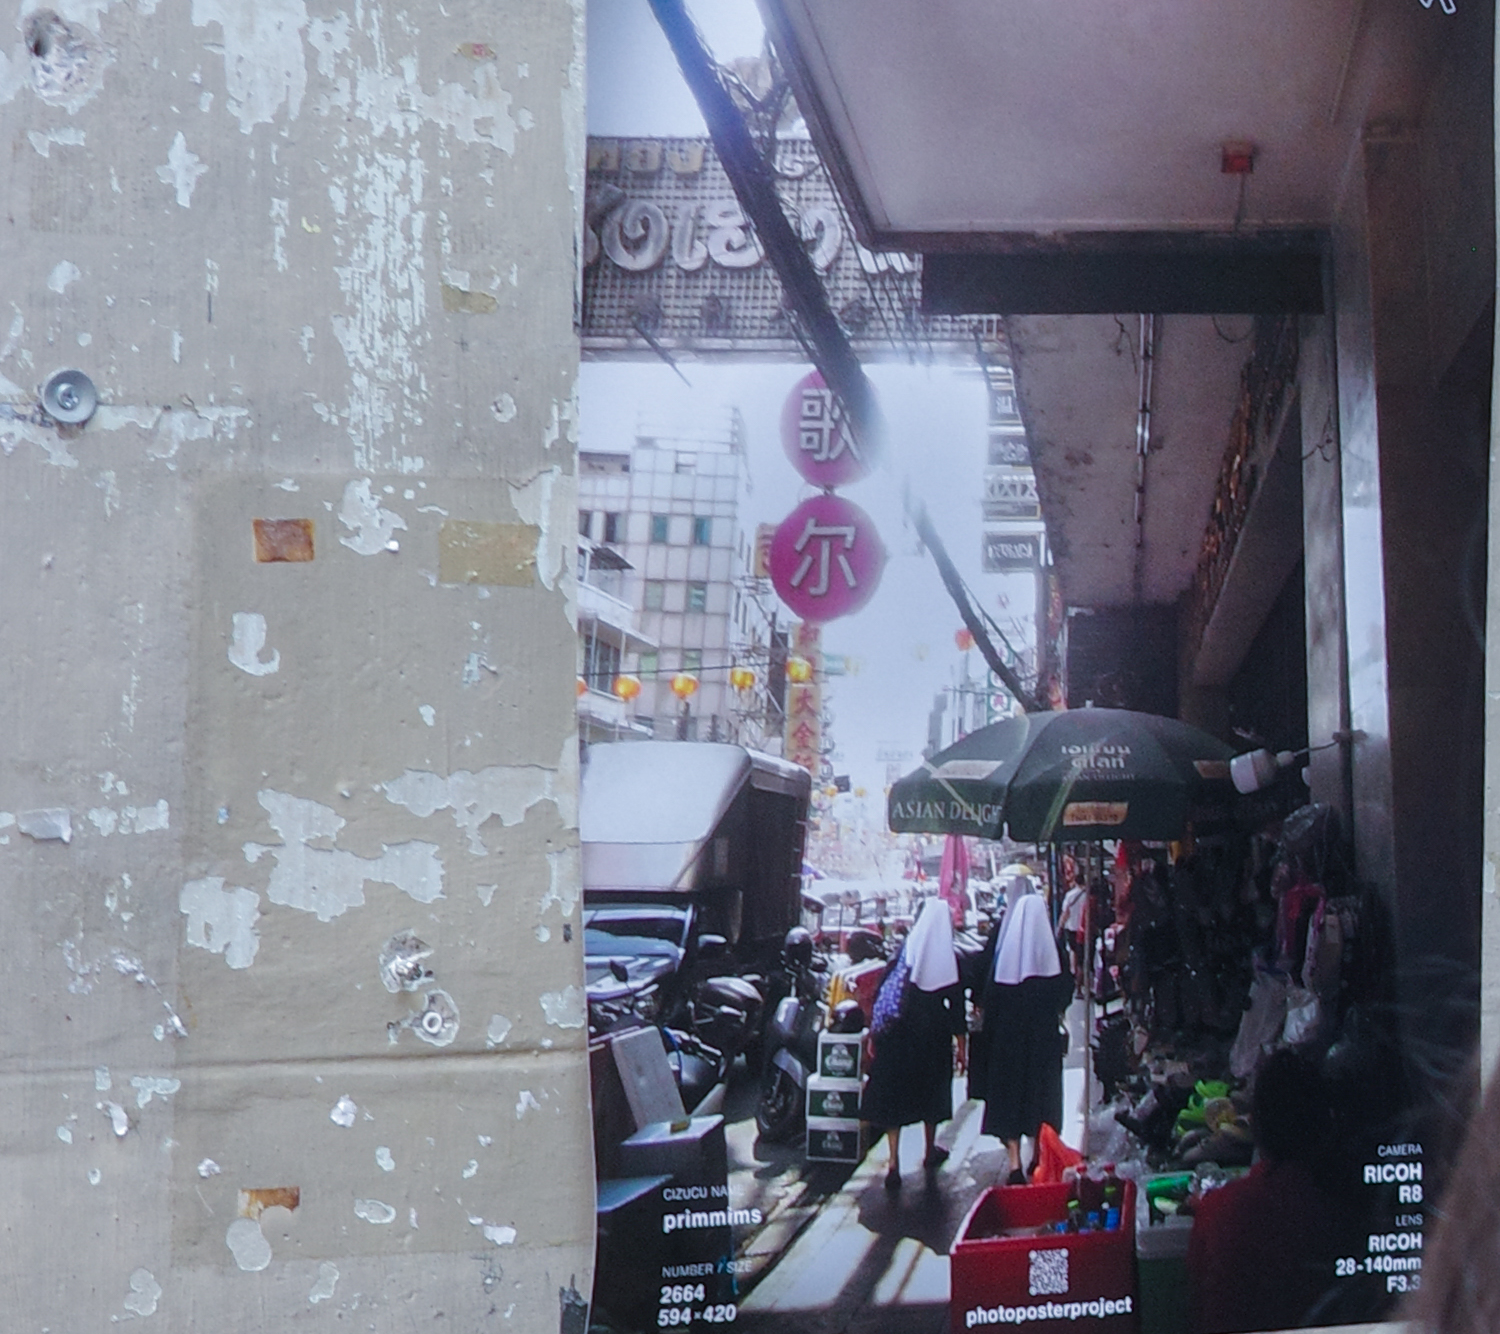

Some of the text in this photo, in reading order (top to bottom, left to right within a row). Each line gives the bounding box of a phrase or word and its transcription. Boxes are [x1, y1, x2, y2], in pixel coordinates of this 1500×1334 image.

[892, 801, 945, 818] ASIAN
[1377, 1143, 1423, 1157] CAMERA
[1363, 1162, 1423, 1184] RICOH
[662, 1186, 708, 1201] CIZUCU
[1398, 1184, 1424, 1204] R8
[662, 1206, 763, 1234] primmims
[1395, 1214, 1423, 1227] LENS
[1368, 1232, 1423, 1252] RICOH
[662, 1263, 714, 1278] NUMBER
[726, 1260, 753, 1274] SIZE
[1335, 1254, 1422, 1276] 28-140mm
[659, 1283, 705, 1304] 2664
[1386, 1274, 1421, 1293] F3.3
[965, 1295, 1133, 1328] photoposterproject
